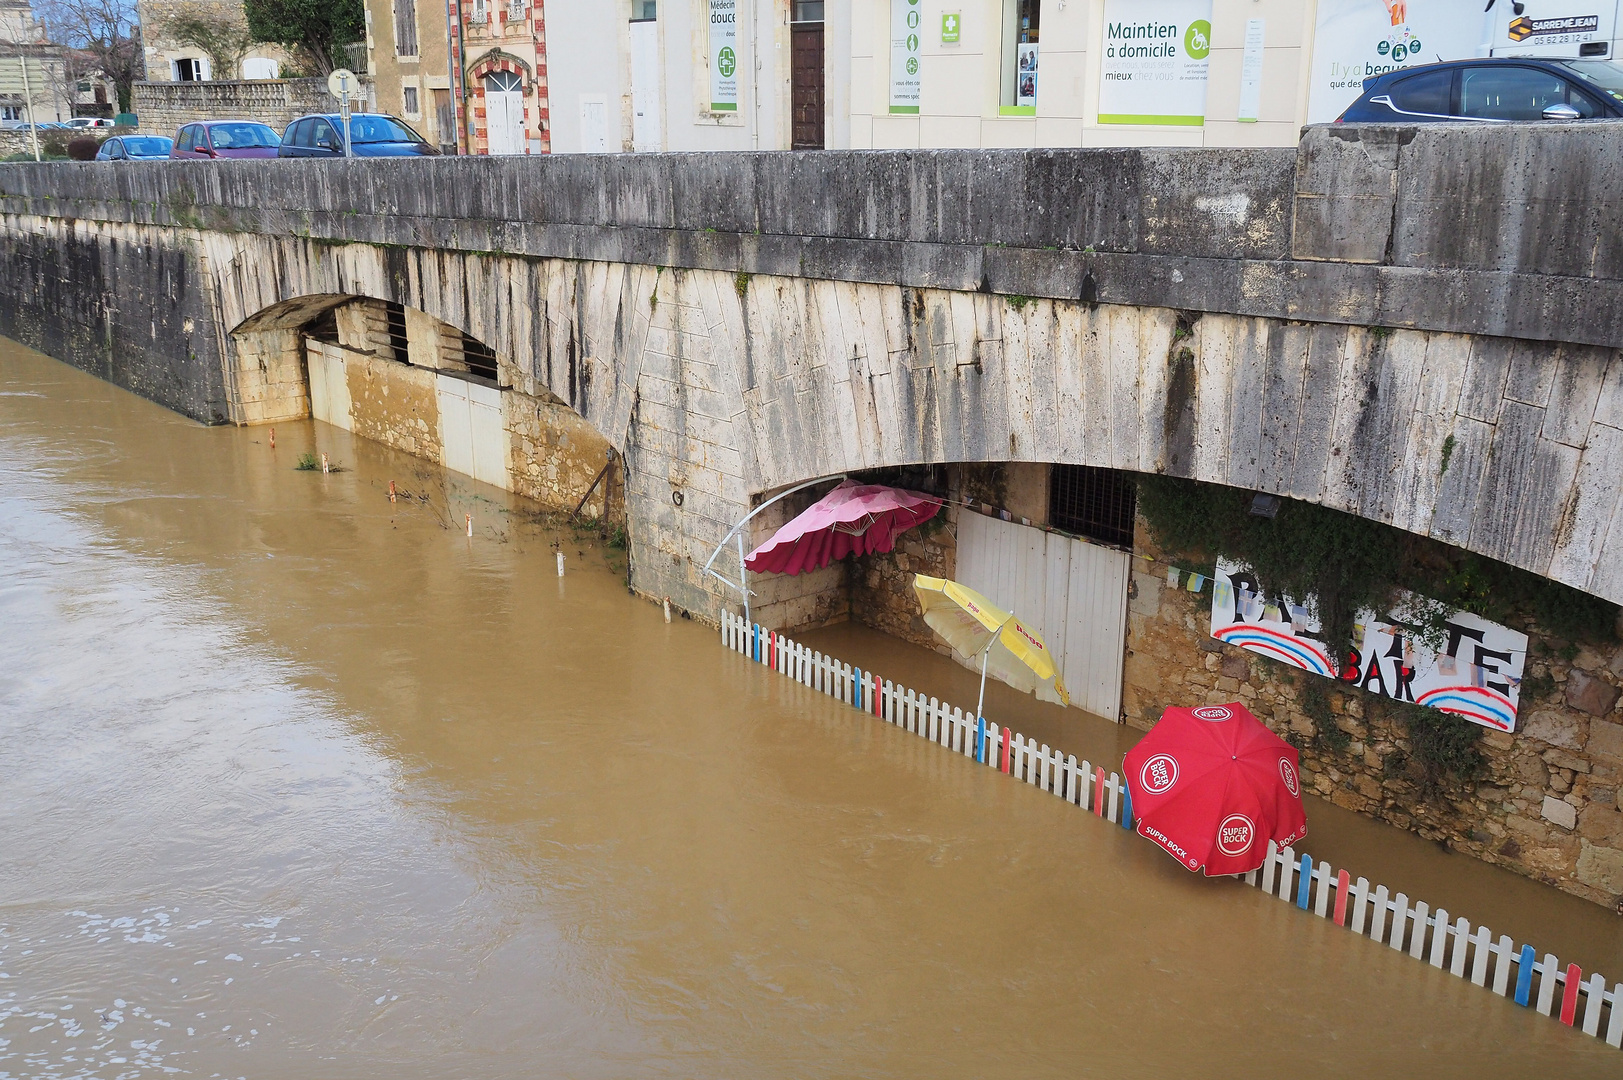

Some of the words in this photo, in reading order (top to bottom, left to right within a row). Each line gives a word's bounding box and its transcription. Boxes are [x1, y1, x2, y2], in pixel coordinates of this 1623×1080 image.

[1108, 22, 1177, 39] Maintien
[1532, 17, 1597, 30] SARREMÉJEAN
[1534, 36, 1544, 45] 05
[1547, 36, 1556, 44] 62
[1559, 35, 1569, 43] 28
[1573, 34, 1580, 42] 12
[1583, 33, 1592, 41] 41
[1107, 43, 1115, 58] à
[1119, 42, 1176, 58] domicile
[1105, 71, 1132, 81] mieux
[1134, 71, 1152, 81] chez
[1155, 72, 1174, 81] vous
[1330, 81, 1346, 90] que
[1347, 79, 1362, 88] des
[1343, 645, 1416, 704] BAR
[1150, 764, 1162, 787] BOCK
[1156, 759, 1169, 785] SUPER
[1222, 826, 1248, 836] SUPER
[1145, 826, 1167, 844] SUPER
[1166, 841, 1187, 859] BOCK
[1223, 835, 1247, 844] BOCK
[1279, 832, 1297, 847] BOCK
